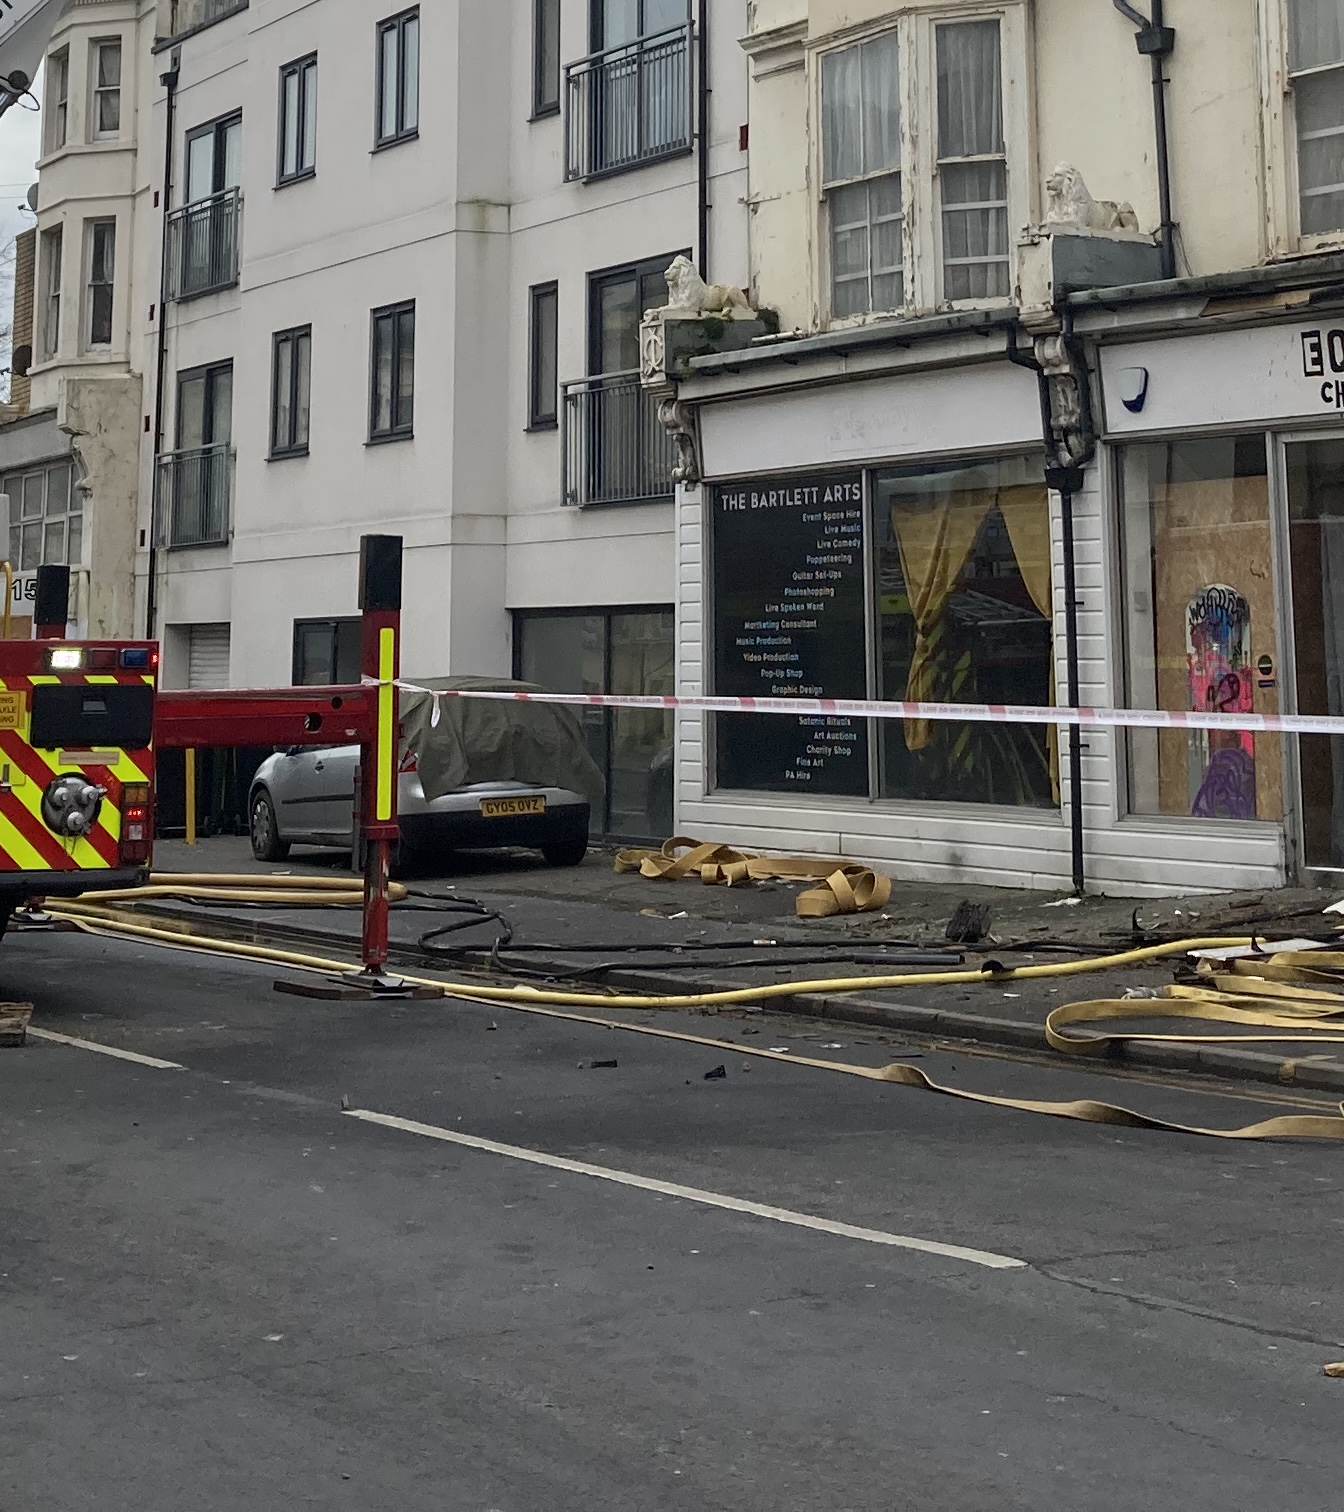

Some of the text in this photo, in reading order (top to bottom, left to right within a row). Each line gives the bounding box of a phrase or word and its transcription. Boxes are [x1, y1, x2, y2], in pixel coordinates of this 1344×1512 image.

[721, 483, 861, 511] THE BARTLETT ARTS
[802, 509, 861, 523] Event Space Hire
[824, 523, 861, 534] Live Music
[817, 538, 861, 549] Live Comedy
[792, 571, 813, 581] Guitar
[784, 587, 835, 598] Photoshopping
[764, 602, 825, 613] Live Spoken Word
[781, 619, 817, 629] Consultant
[735, 636, 792, 646] Music Production
[743, 652, 799, 662] Video Production
[760, 668, 804, 678] Pop-Up Shop
[771, 684, 823, 696] Graphic Design
[813, 731, 857, 741] Art Auctions
[806, 744, 852, 756] Charity Shop
[796, 757, 824, 767] Fine Art
[785, 770, 811, 780] PA Hire
